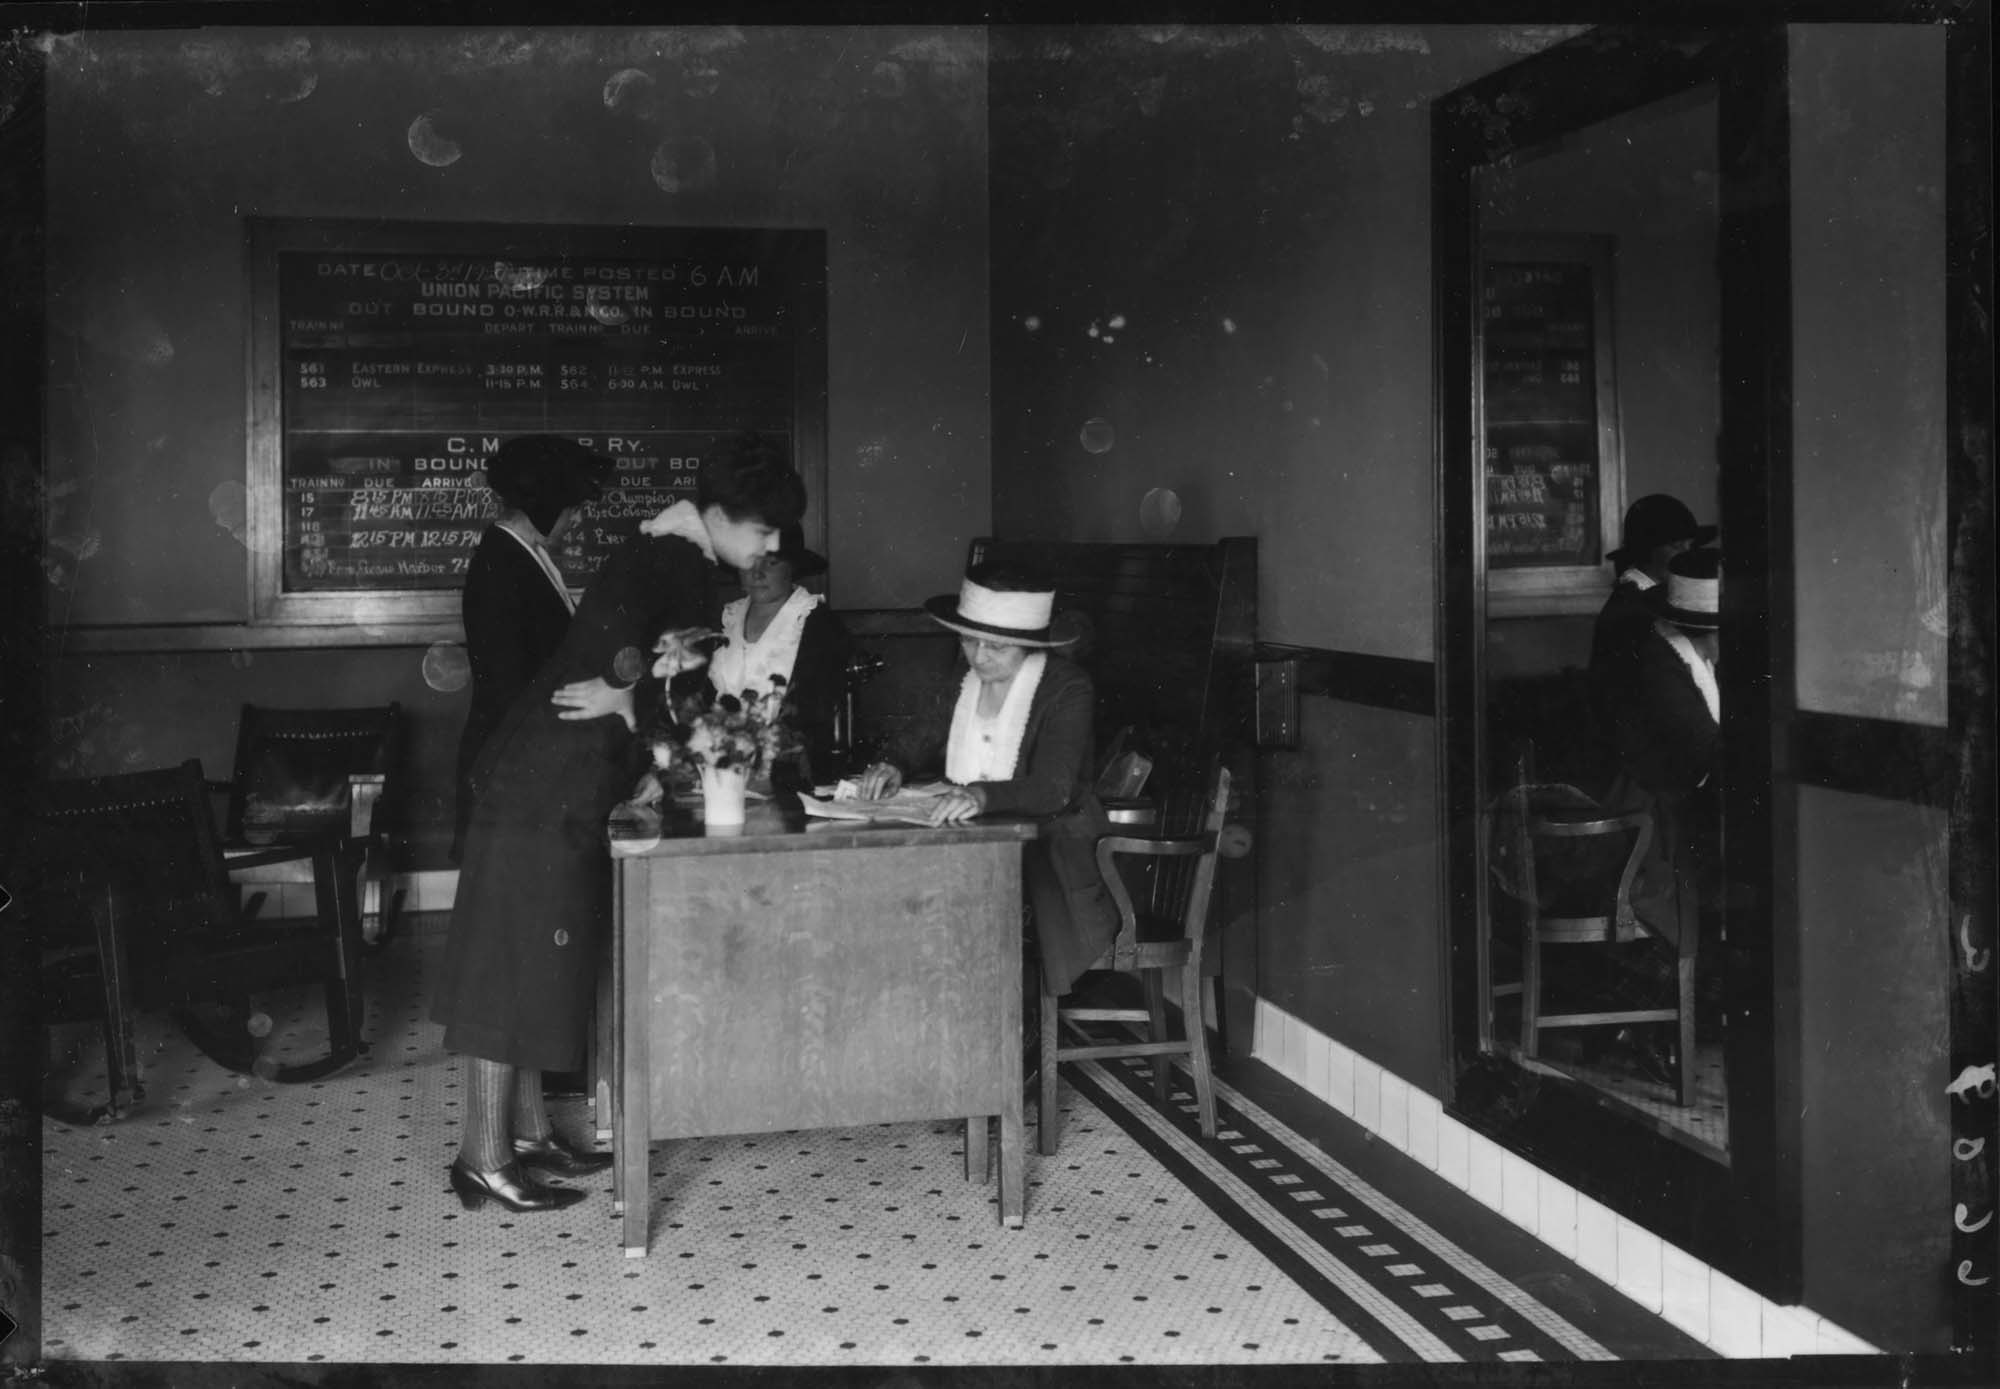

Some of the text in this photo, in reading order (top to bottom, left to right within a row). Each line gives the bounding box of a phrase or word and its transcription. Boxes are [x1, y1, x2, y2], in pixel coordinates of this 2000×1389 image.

[317, 262, 377, 277] DATE
[583, 266, 676, 281] POSTED
[690, 265, 707, 287] 6
[421, 282, 649, 301] UNION PACIFIC SYSTEM
[350, 302, 393, 315] OUT
[412, 303, 495, 317] BOUND
[633, 306, 653, 318] IN
[664, 305, 747, 319] BOUND
[484, 322, 536, 334] DEPART
[621, 323, 652, 335] DUE
[351, 361, 411, 375] EASTERN
[672, 363, 722, 376] EXPRESS
[300, 376, 328, 389] 563
[351, 377, 383, 389] OWL
[560, 379, 589, 390] 564
[672, 379, 700, 391] OWL
[607, 437, 645, 453] RY.
[369, 458, 391, 469] IN
[616, 457, 659, 470] OUT
[363, 478, 395, 489] DUE
[620, 476, 651, 487] DUE
[301, 492, 314, 503] 15
[391, 489, 413, 505] PM
[301, 507, 314, 518] 17
[389, 531, 416, 548] PM
